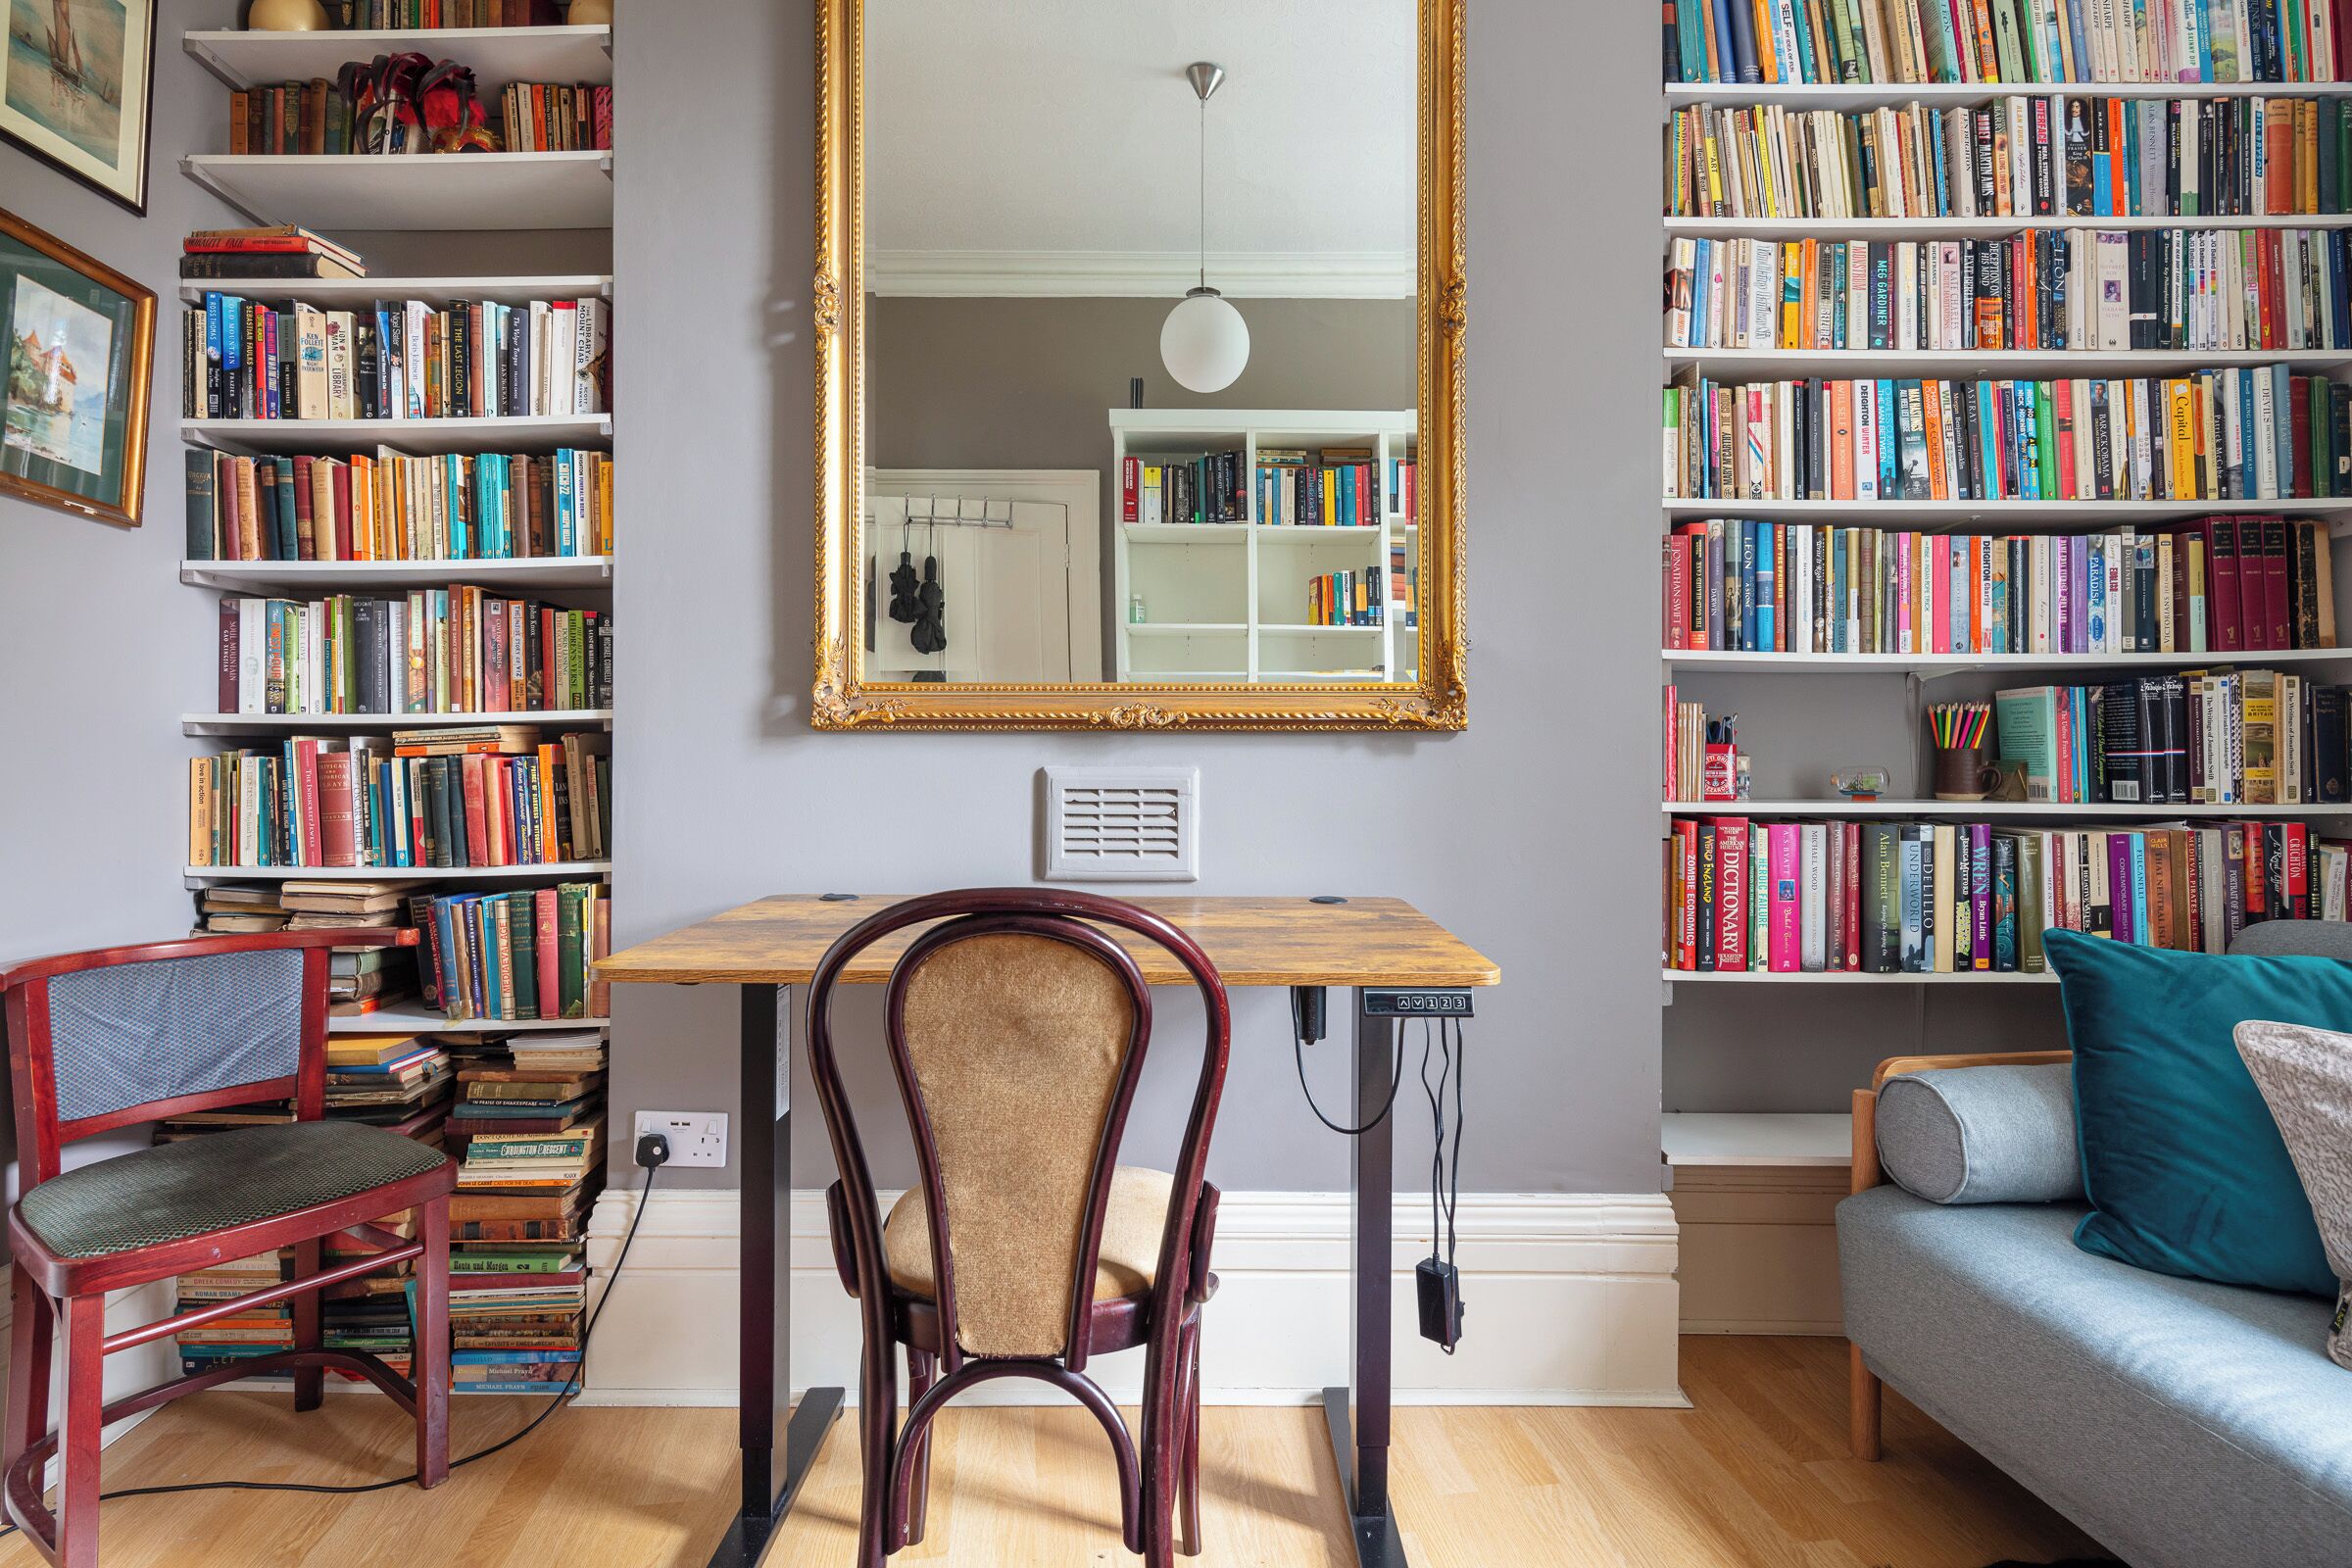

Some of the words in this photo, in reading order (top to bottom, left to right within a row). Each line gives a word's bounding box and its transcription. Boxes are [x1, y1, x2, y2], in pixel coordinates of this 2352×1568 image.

[1782, 4, 1791, 27] SELF
[2035, 100, 2047, 144] INTERFACE
[1979, 145, 1991, 175] MARTIN
[1698, 176, 1707, 192] Read
[1982, 177, 1993, 196] AMIS
[1851, 246, 1866, 291] MONSTRUM
[1878, 261, 1886, 279] MEG
[1981, 266, 1989, 286] MIND
[1988, 243, 1999, 282] DECEPTION
[2054, 248, 2064, 291] LEON
[1877, 282, 1886, 325] GARDINER
[1964, 278, 1974, 307] BERLIN
[1989, 285, 2000, 296] ON
[455, 328, 464, 343] THE
[1821, 309, 1831, 340] SEIZURE
[411, 335, 419, 351] Boris
[455, 345, 464, 364] LAST
[411, 353, 419, 380] Johnson
[455, 367, 464, 395] LEGION
[332, 368, 342, 399] LIBRARY
[1908, 388, 1921, 401] MAX
[1860, 385, 1869, 426] DEIGHTON
[1909, 403, 1923, 432] HASTINGS
[1967, 386, 1977, 423] ASTRAY
[2174, 396, 2191, 441] Capital
[1954, 416, 1963, 443] Benjamin
[1957, 445, 1966, 469] Franklin
[2100, 448, 2109, 478] OBAMA
[1744, 537, 1753, 569] LEON
[1672, 549, 1681, 596] JONATHAN
[2090, 557, 2099, 604] PARADISE
[271, 653, 282, 679] HOUR
[354, 788, 363, 815] OSCAR
[355, 817, 364, 846] WILDE
[1880, 833, 1890, 857] Alan
[1687, 855, 1695, 890] ZOMBIE
[1758, 858, 1768, 888] HEROIC
[1973, 847, 1986, 894] WREN
[2290, 838, 2300, 878] CRICHTON
[1703, 864, 1713, 903] ENGLAND
[1880, 861, 1890, 899] Bennett
[1909, 845, 1921, 932] UNDERWORLD
[1723, 853, 1739, 953] DICTIONARY
[1758, 891, 1768, 928] FAILURE
[500, 921, 509, 939] AGE
[1687, 892, 1695, 946] ECONOMICS
[500, 942, 512, 994] MEDIAEVAL
[1443, 999, 1448, 1007] 2
